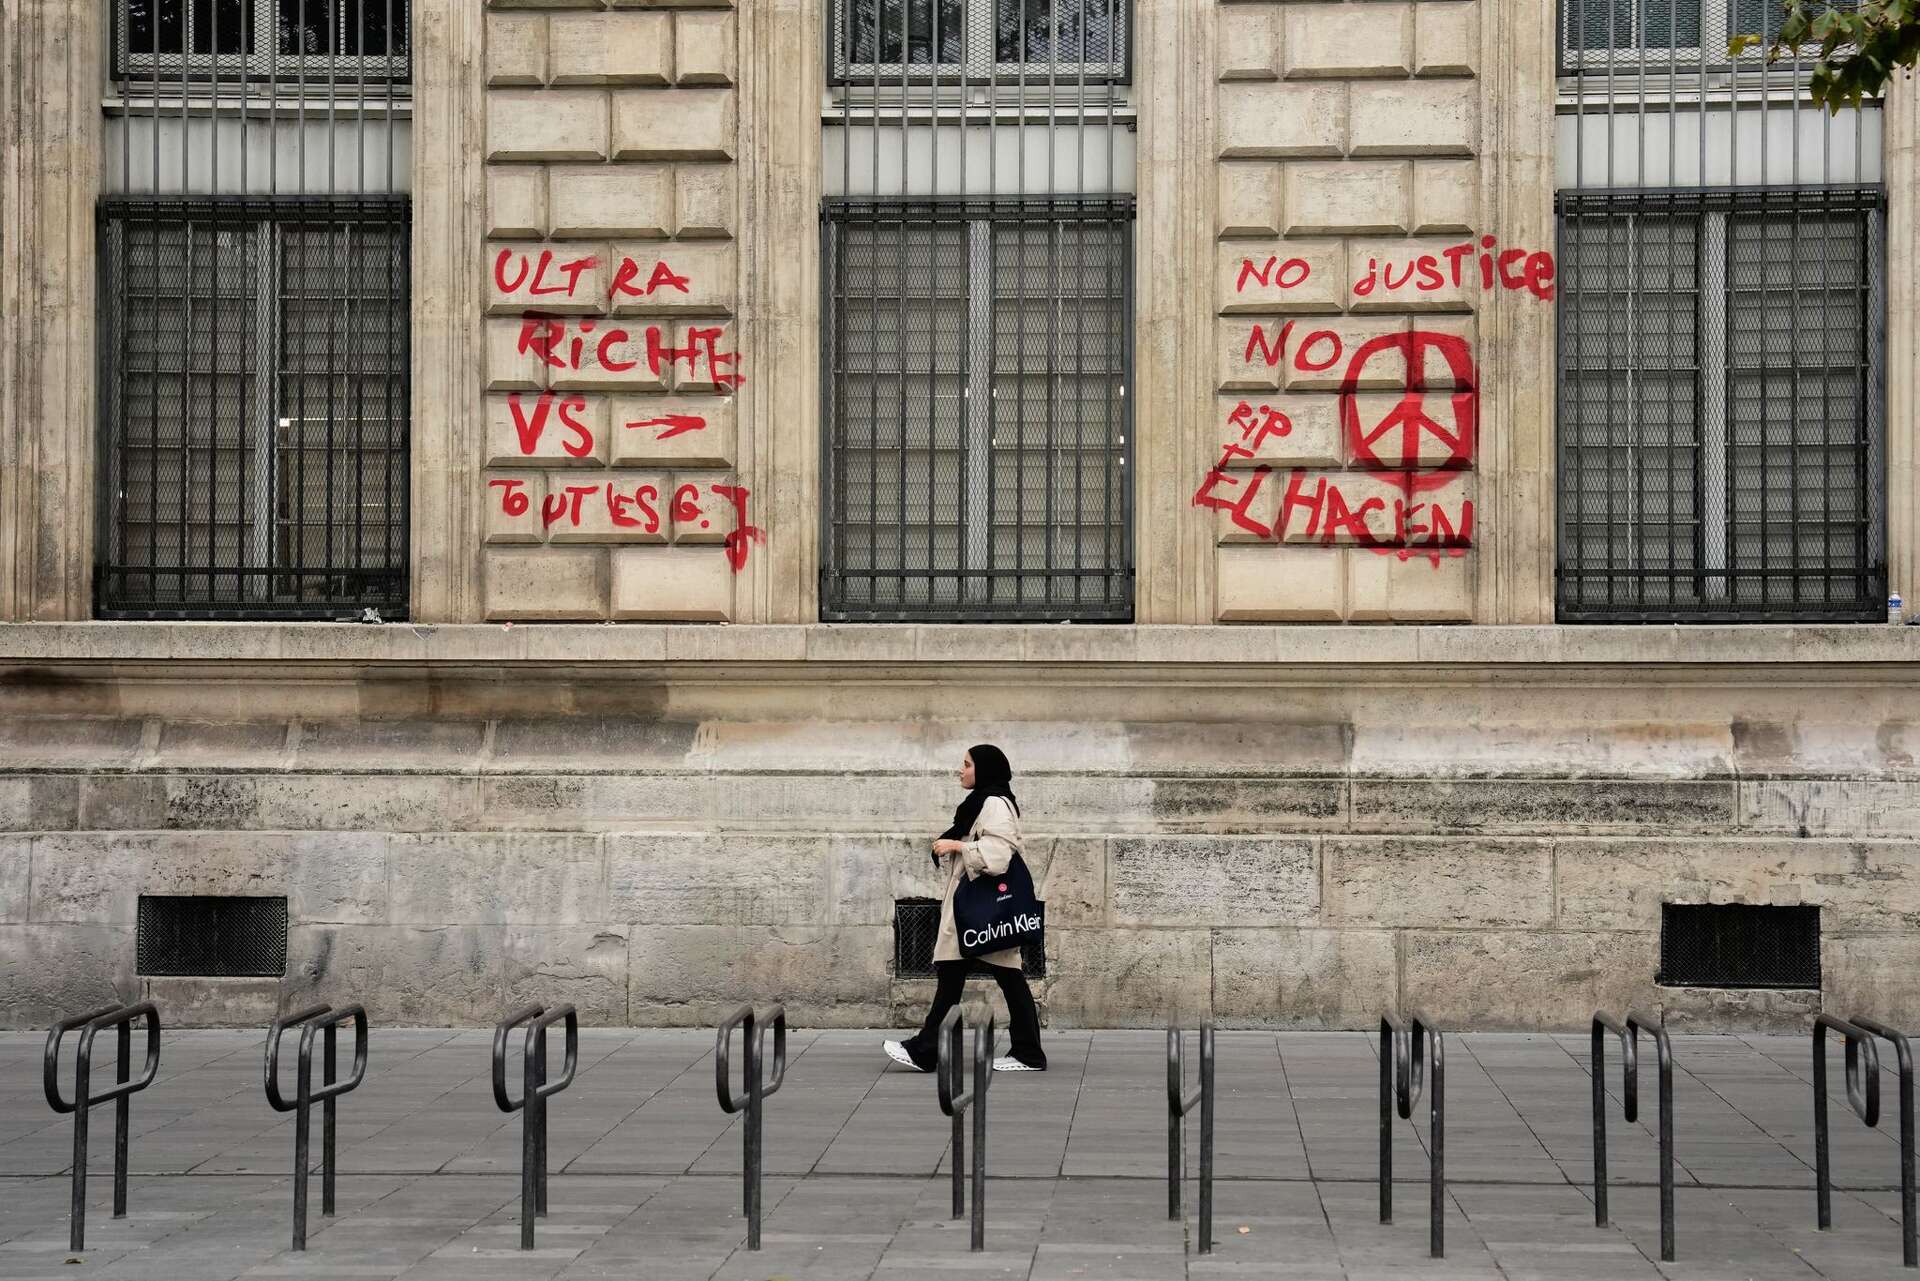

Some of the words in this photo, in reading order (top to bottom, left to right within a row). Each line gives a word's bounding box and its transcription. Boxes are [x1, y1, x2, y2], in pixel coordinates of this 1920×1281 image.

[495, 248, 689, 298] ULTRA
[1236, 255, 1311, 292] NO
[1245, 320, 1343, 373] NO
[508, 390, 595, 458] VS
[963, 920, 1013, 947] Calvin
